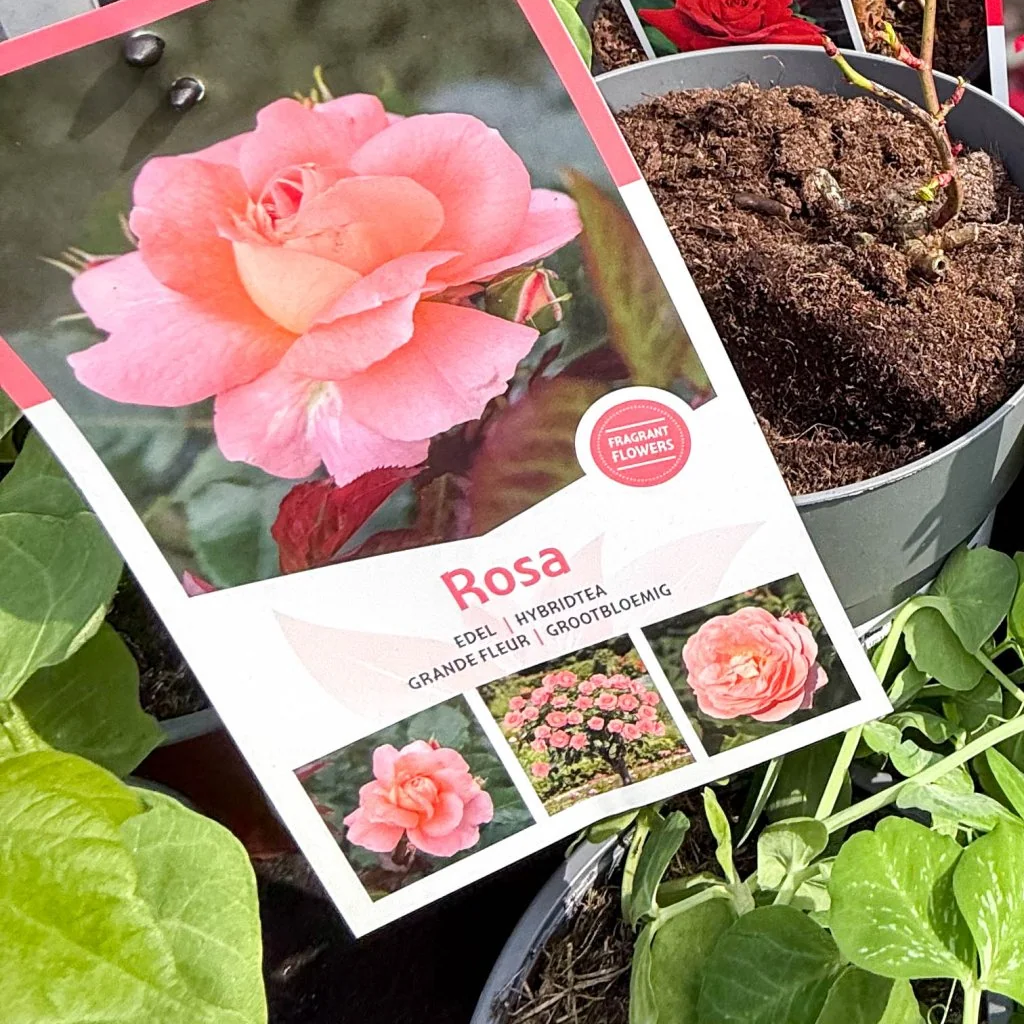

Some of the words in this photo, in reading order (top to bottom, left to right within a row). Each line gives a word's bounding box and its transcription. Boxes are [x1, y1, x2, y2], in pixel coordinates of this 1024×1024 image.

[608, 425, 669, 448] FRAGRANT
[611, 438, 675, 463] FLOWERS
[440, 547, 571, 611] Rosa
[407, 655, 477, 690] GRANDE
[480, 634, 531, 663] FLEUR
[545, 583, 672, 637] GROOTBLOEMIG
[453, 624, 497, 649] EDEL
[514, 584, 608, 626] HYBRIDTEA
